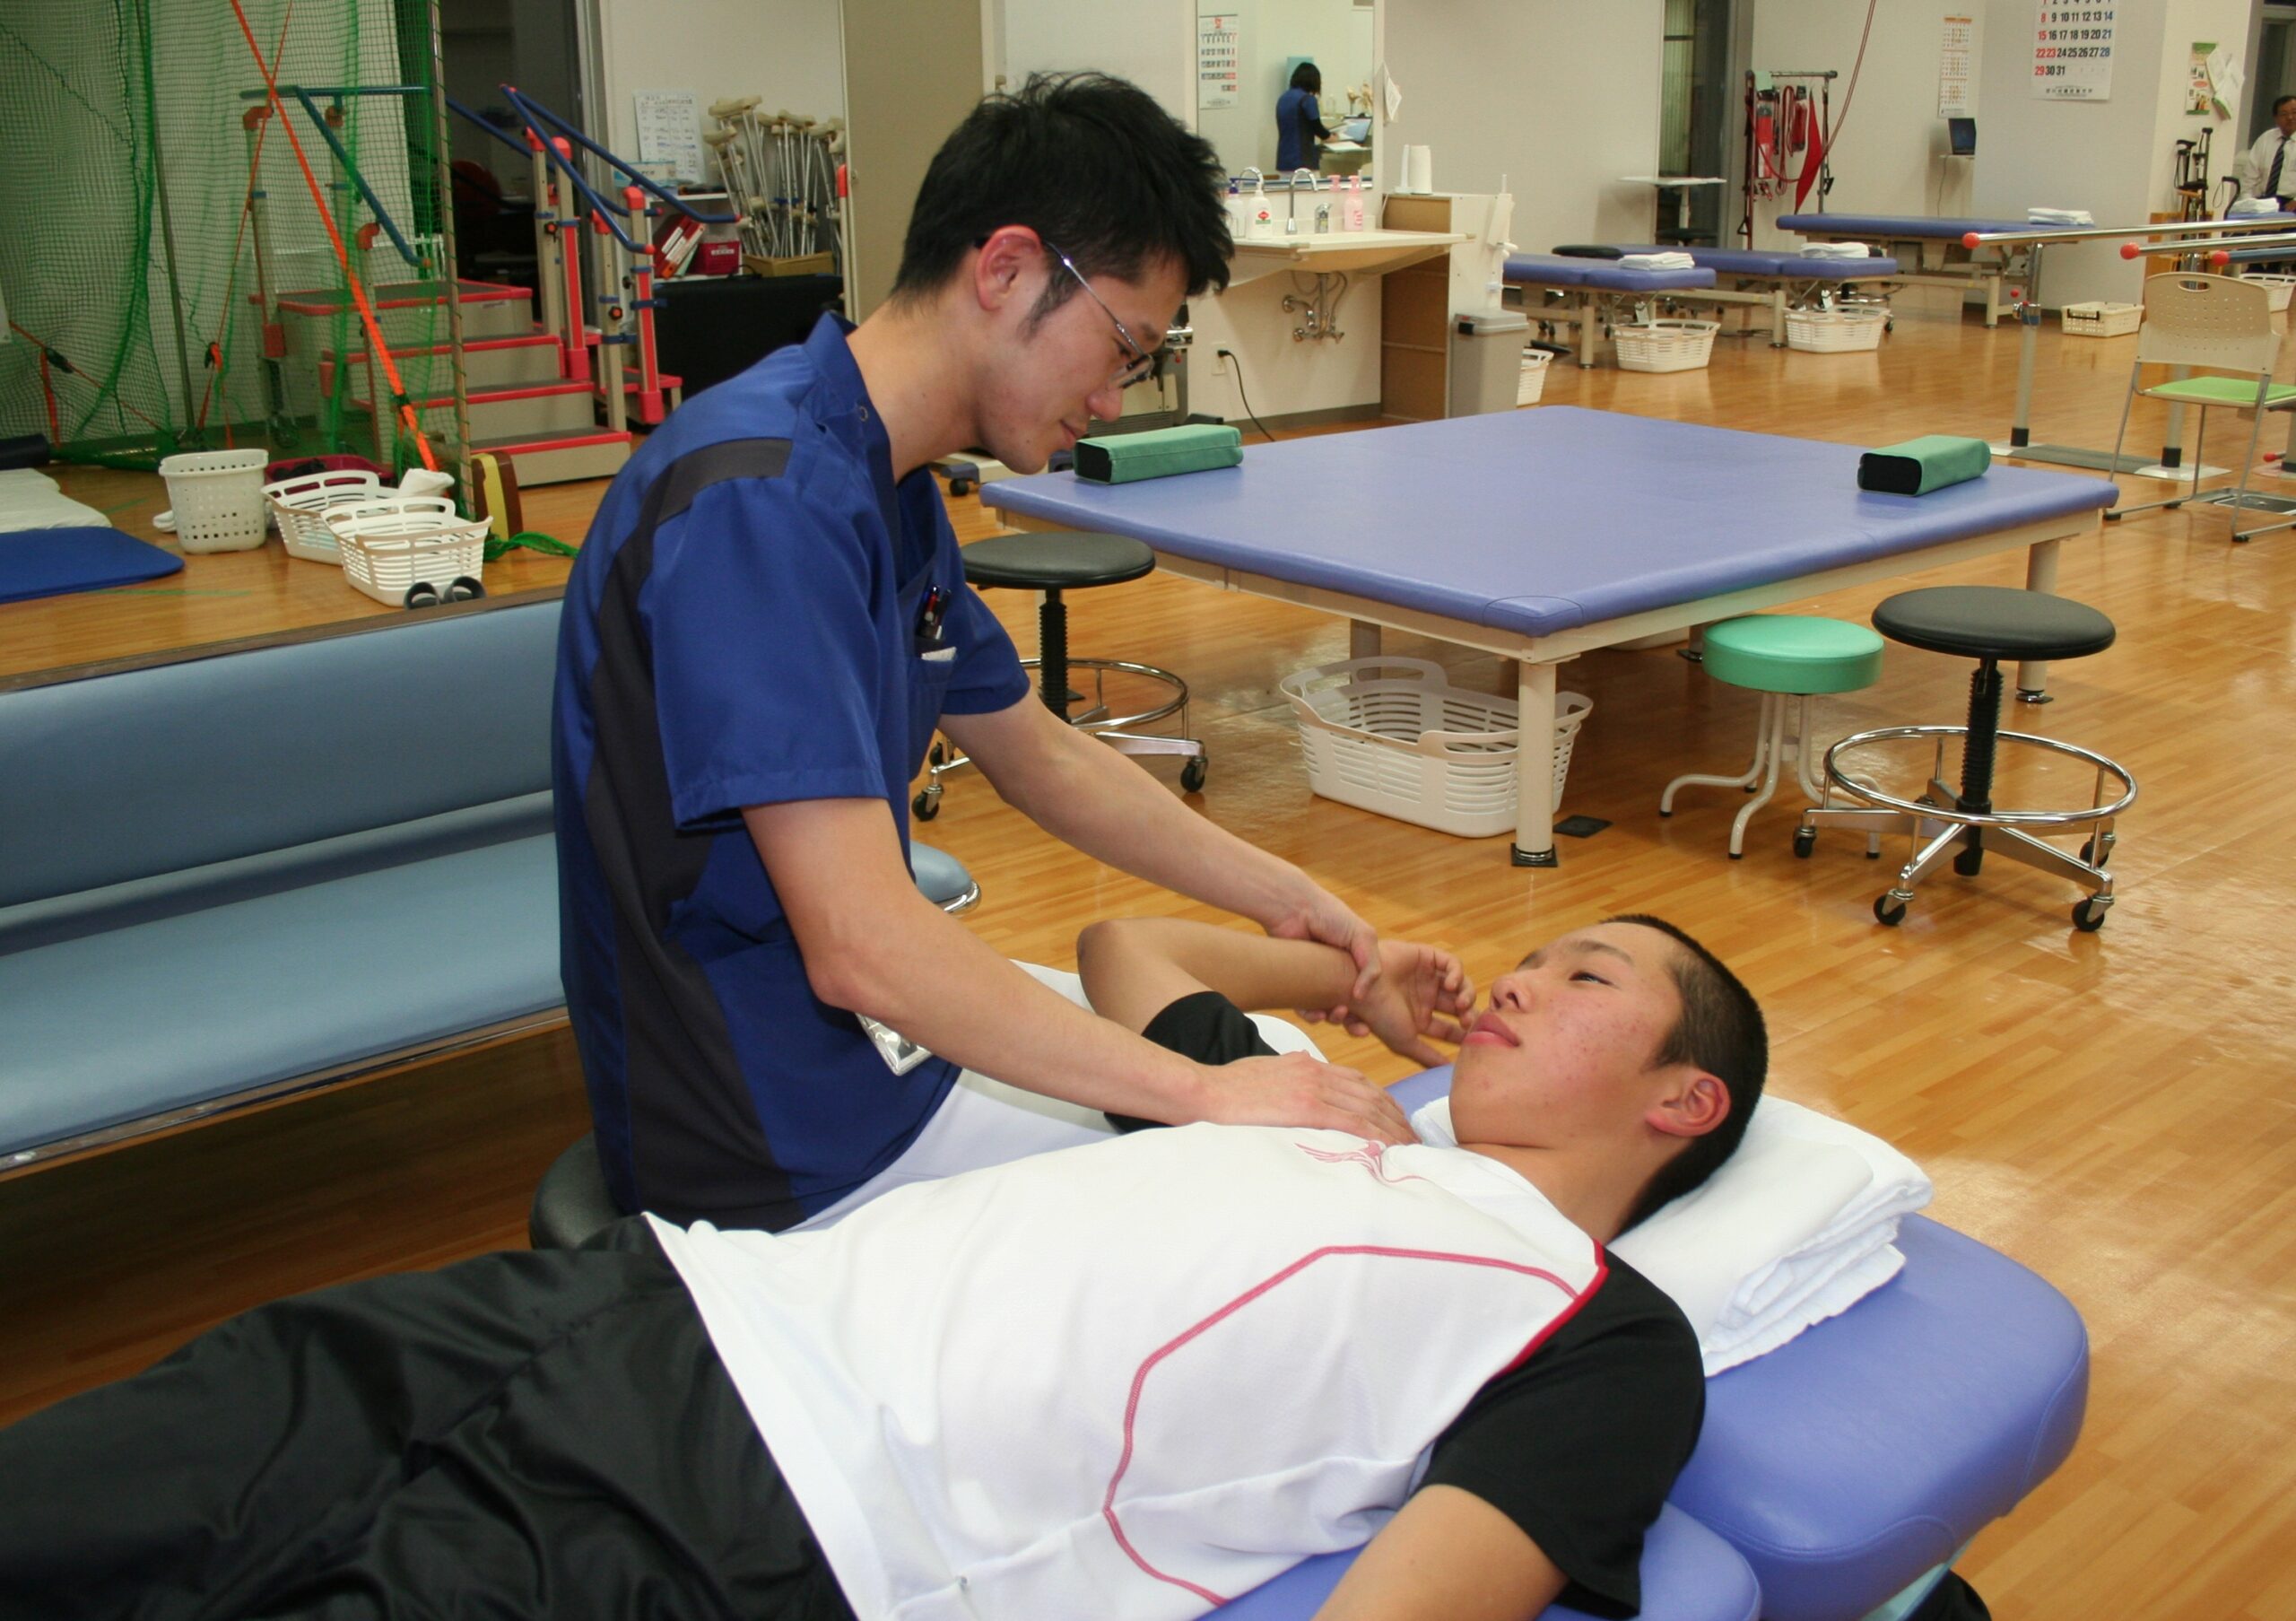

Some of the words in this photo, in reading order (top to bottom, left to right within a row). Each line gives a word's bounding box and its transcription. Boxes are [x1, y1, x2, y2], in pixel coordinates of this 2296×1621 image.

[2040, 13, 2047, 23] 8
[2051, 13, 2057, 22] 9
[2060, 12, 2069, 22] 10
[2071, 12, 2079, 22] 11
[2082, 12, 2091, 22] 12
[2092, 11, 2101, 22] 13
[2104, 11, 2113, 21] 14
[2038, 31, 2047, 40] 15
[2048, 31, 2057, 40] 16
[2059, 30, 2067, 39] 17
[2070, 30, 2078, 39] 18
[2081, 30, 2090, 39] 19
[2091, 30, 2100, 39] 20
[2101, 29, 2111, 39] 21
[2036, 48, 2045, 58] 22
[2046, 48, 2056, 58] 23
[2057, 48, 2066, 57] 24
[2067, 48, 2077, 57] 25
[2078, 48, 2088, 57] 26
[2088, 48, 2099, 57] 27
[2100, 47, 2110, 57] 28
[2034, 65, 2045, 75] 29
[2045, 65, 2055, 75] 30
[2056, 65, 2066, 75] 31
